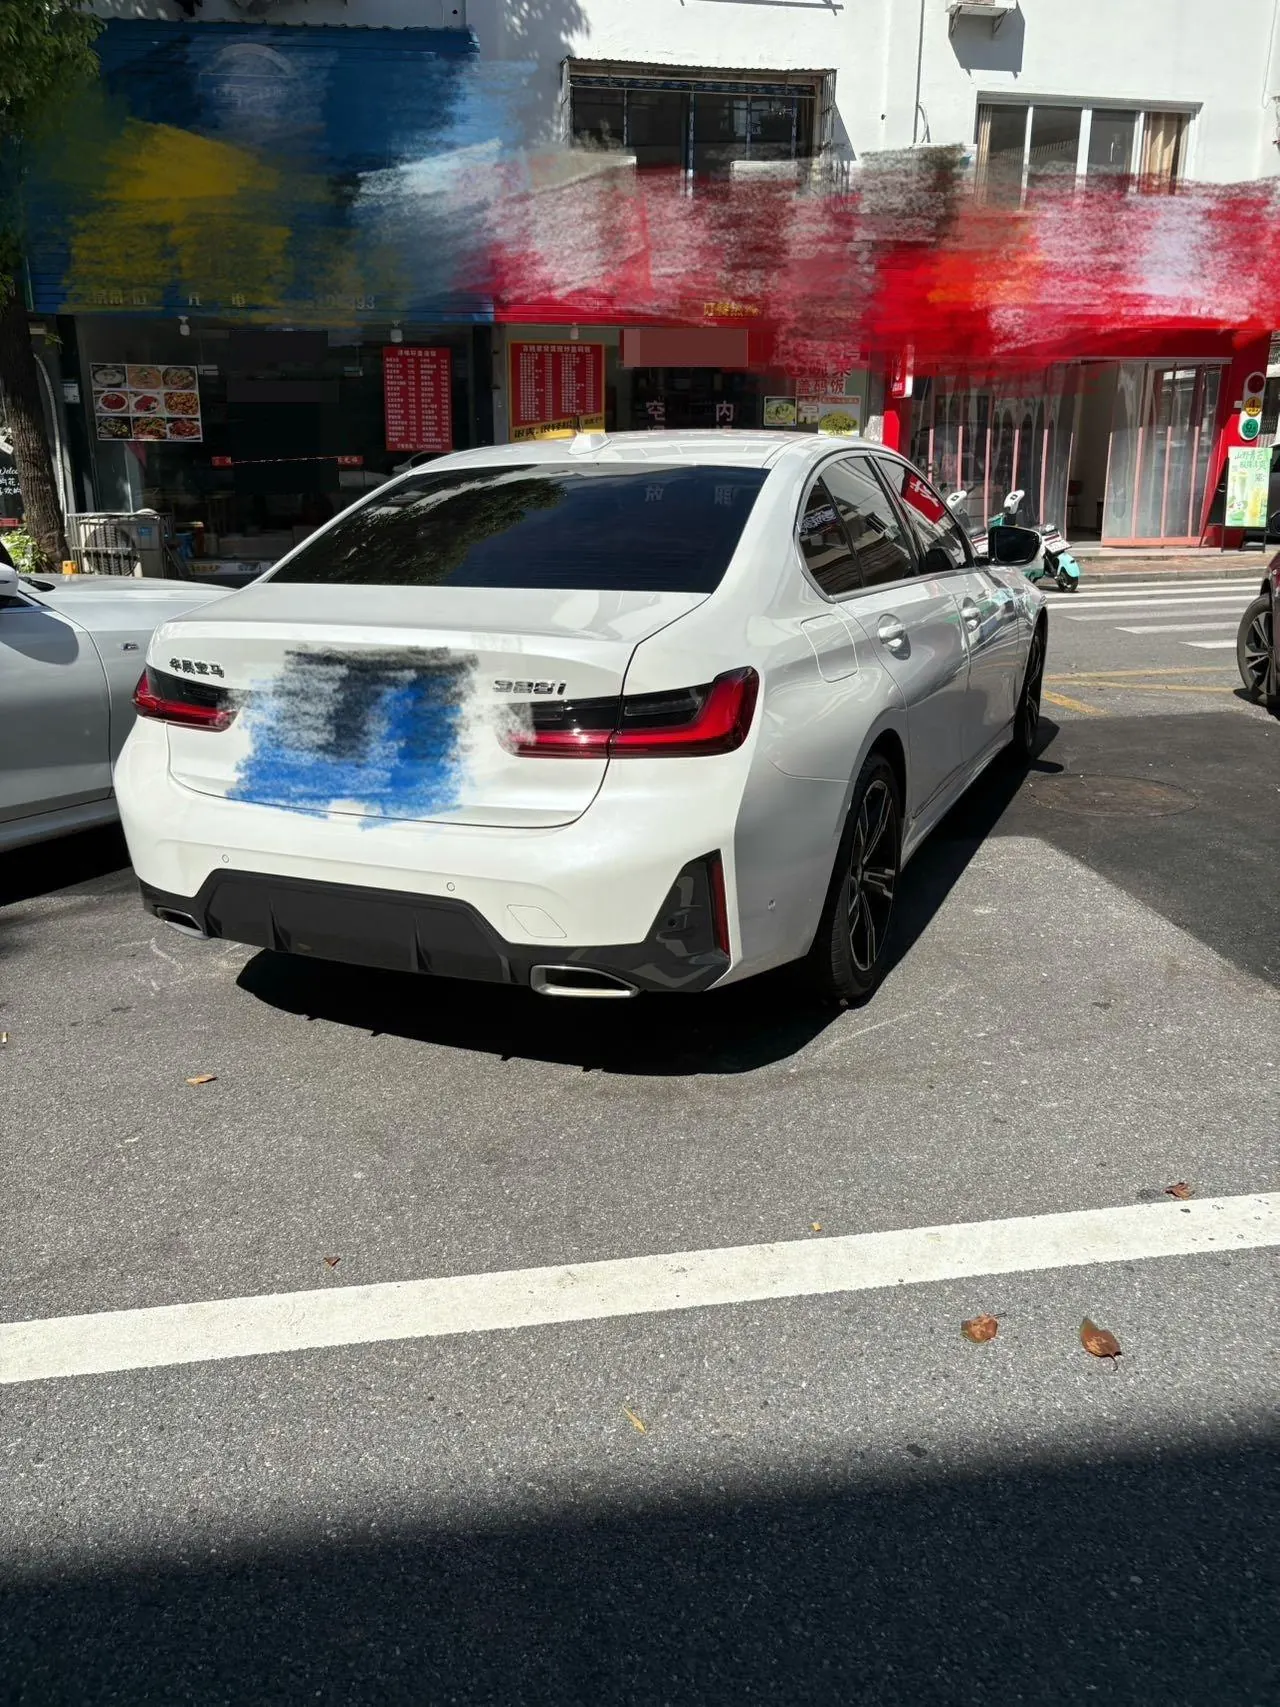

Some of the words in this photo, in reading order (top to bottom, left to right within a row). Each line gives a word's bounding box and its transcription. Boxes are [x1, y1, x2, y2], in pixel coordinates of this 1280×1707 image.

[646, 400, 666, 421] 空
[716, 400, 734, 422] 内
[169, 657, 224, 678] 华晨宝马
